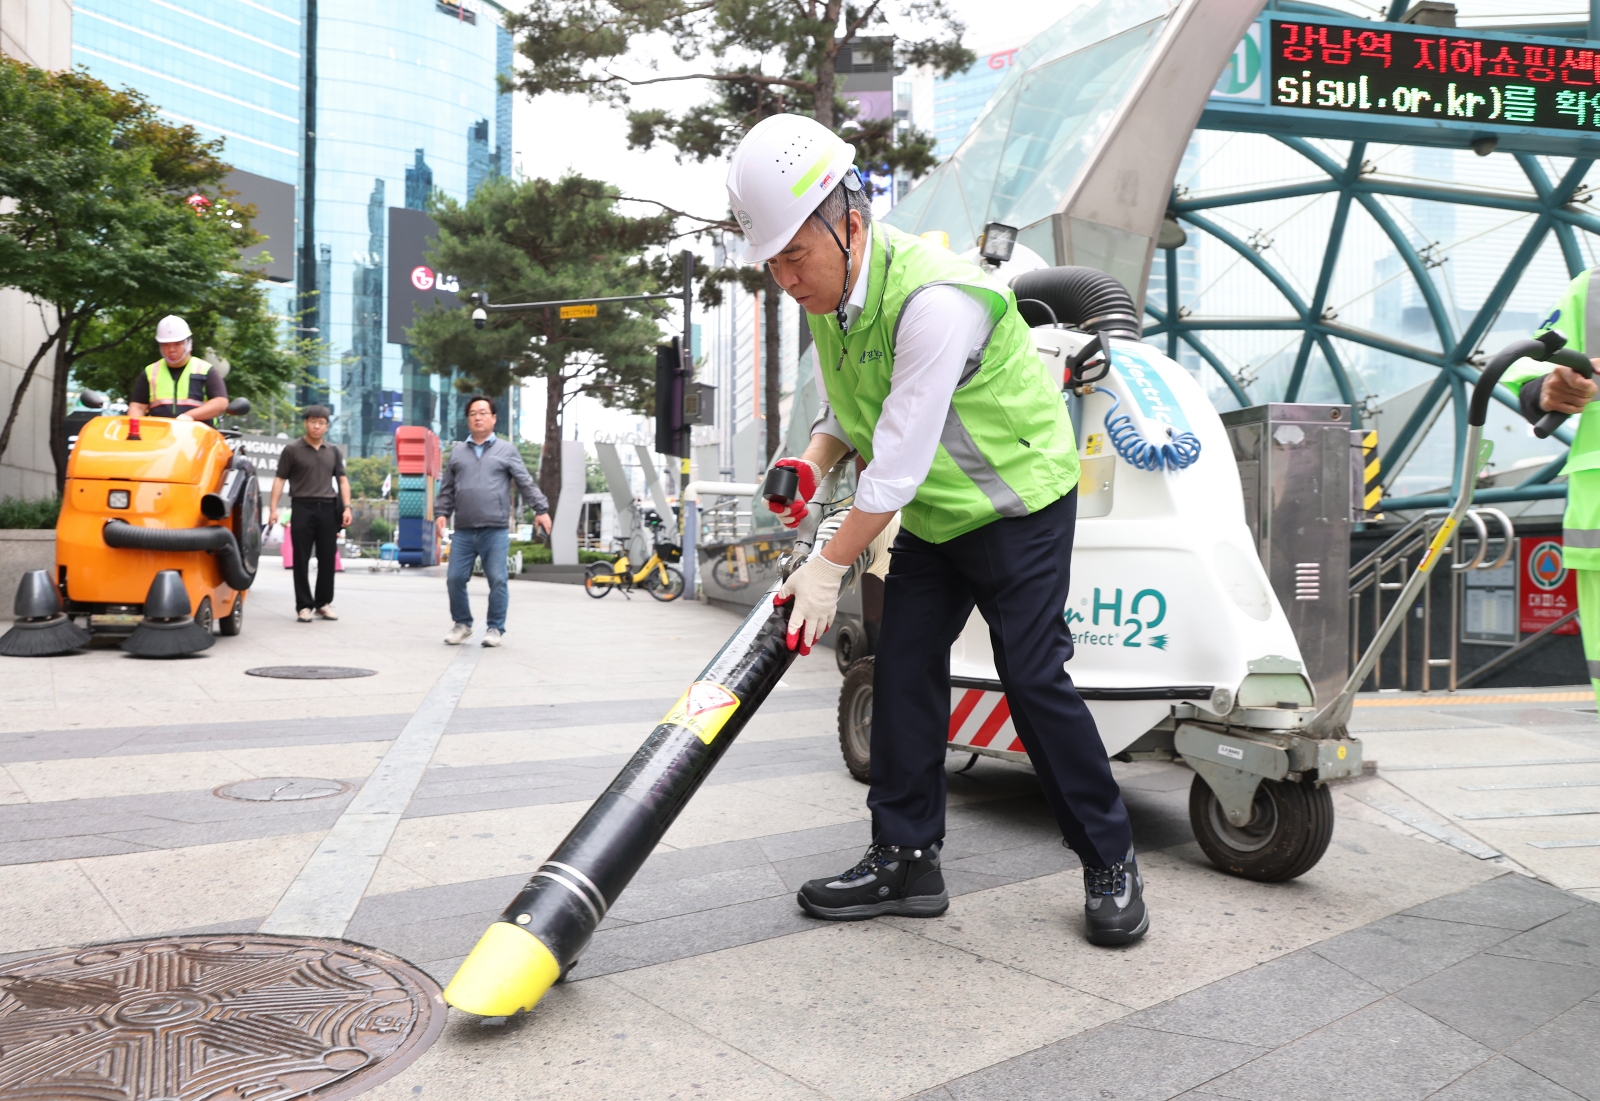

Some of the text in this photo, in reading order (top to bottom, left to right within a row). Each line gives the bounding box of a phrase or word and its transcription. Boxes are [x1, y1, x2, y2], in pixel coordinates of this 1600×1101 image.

[988, 47, 1018, 70] GT
[1231, 38, 1247, 84] 1
[1280, 23, 1392, 69] 강남역
[1277, 70, 1537, 122] sisul.or.kr)를
[1117, 354, 1172, 424] electric
[1528, 593, 1568, 608] 대피소
[1533, 608, 1564, 618] SHELTER
[1072, 631, 1114, 646] erfect
